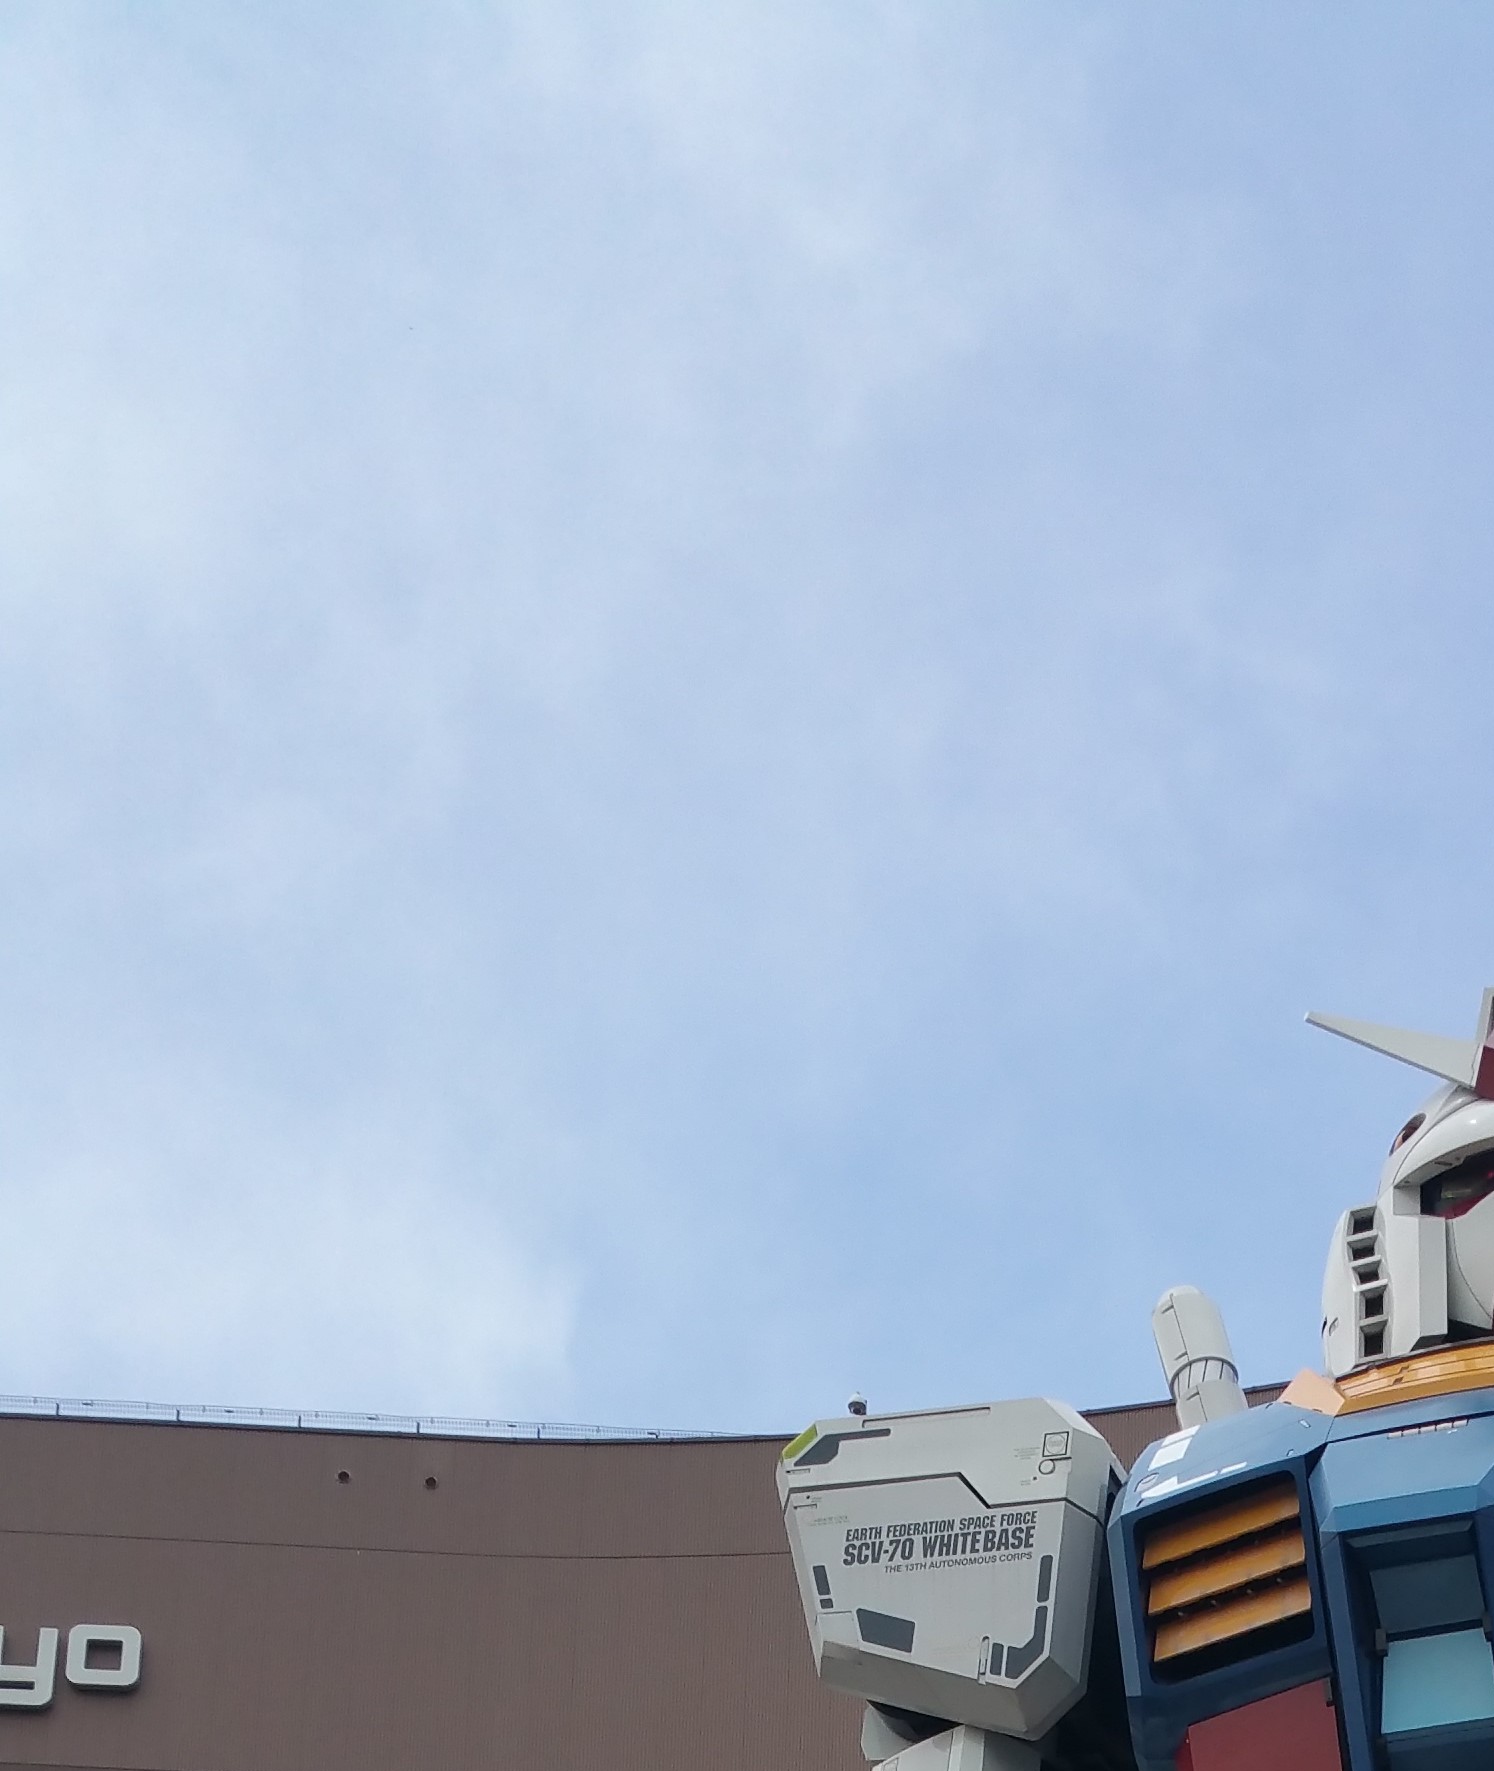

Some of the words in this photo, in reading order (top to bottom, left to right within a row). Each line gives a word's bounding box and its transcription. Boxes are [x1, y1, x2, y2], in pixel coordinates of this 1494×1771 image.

[845, 1524, 882, 1543] EARTH
[886, 1518, 955, 1540] FEDERATION
[958, 1514, 996, 1532] SPACE
[999, 1510, 1038, 1527] FORCE
[842, 1538, 914, 1566] SCV-70
[884, 1564, 903, 1574] THE
[904, 1562, 927, 1572] 13TH
[928, 1555, 997, 1571] AUTONOMOUS
[998, 1551, 1033, 1563] CORPS
